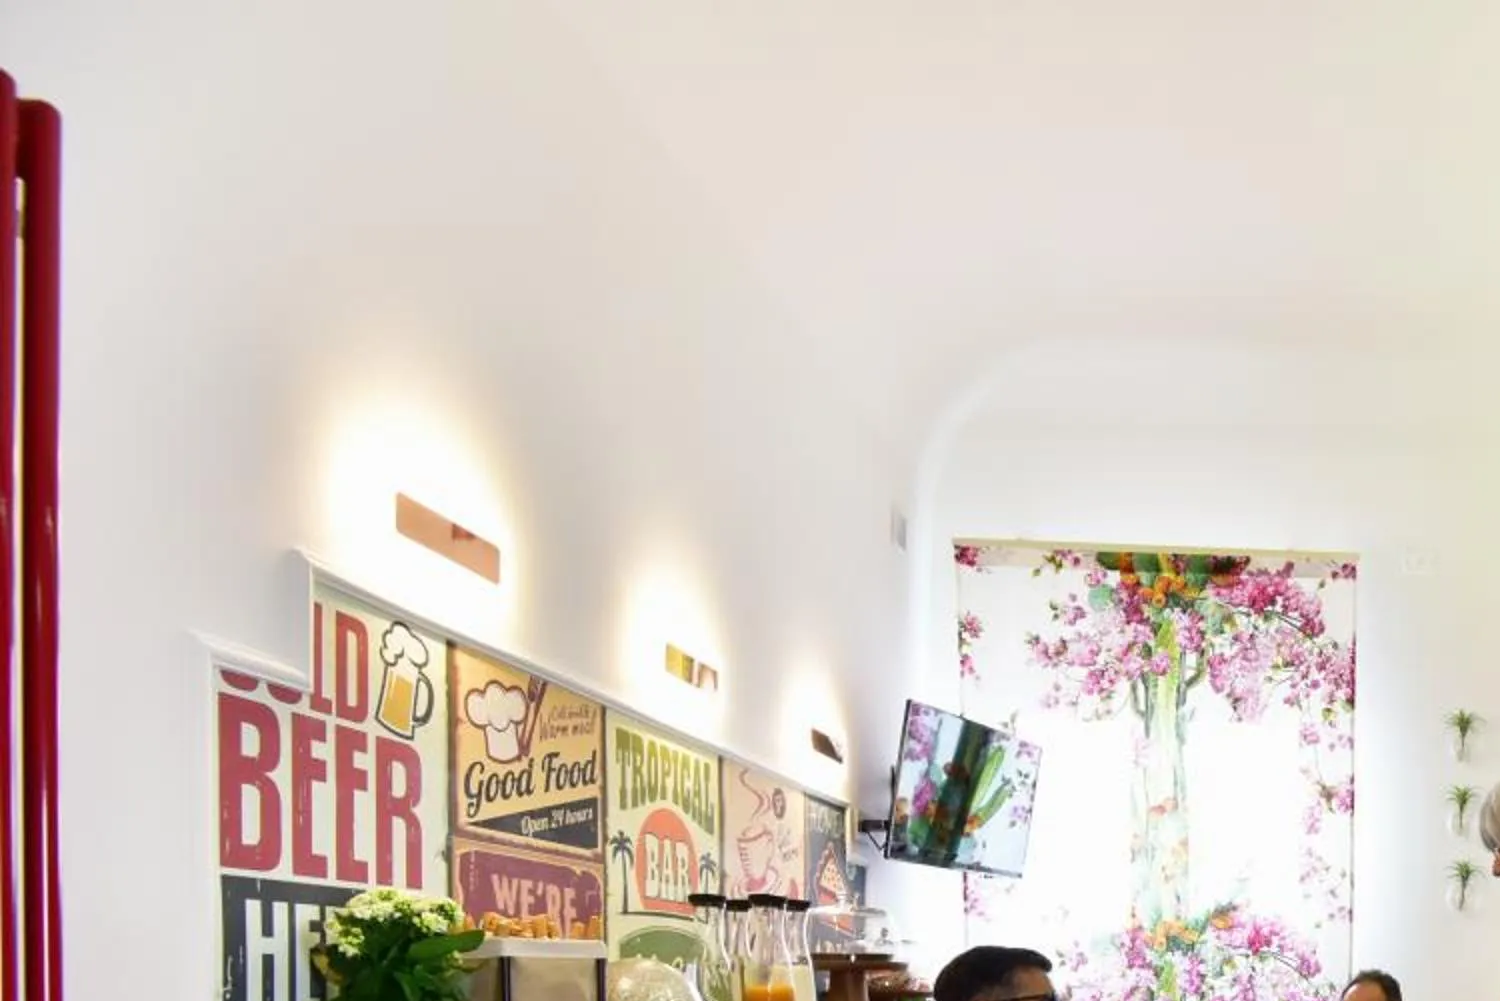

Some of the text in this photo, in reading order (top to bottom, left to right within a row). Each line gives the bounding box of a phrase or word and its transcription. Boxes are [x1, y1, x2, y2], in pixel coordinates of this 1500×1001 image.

[220, 601, 369, 724] LD
[218, 692, 423, 889] BEER
[464, 748, 597, 819] Good Food
[521, 806, 594, 838] Open 24 hours
[616, 727, 714, 835] TROPICAL
[644, 832, 690, 903] BAR
